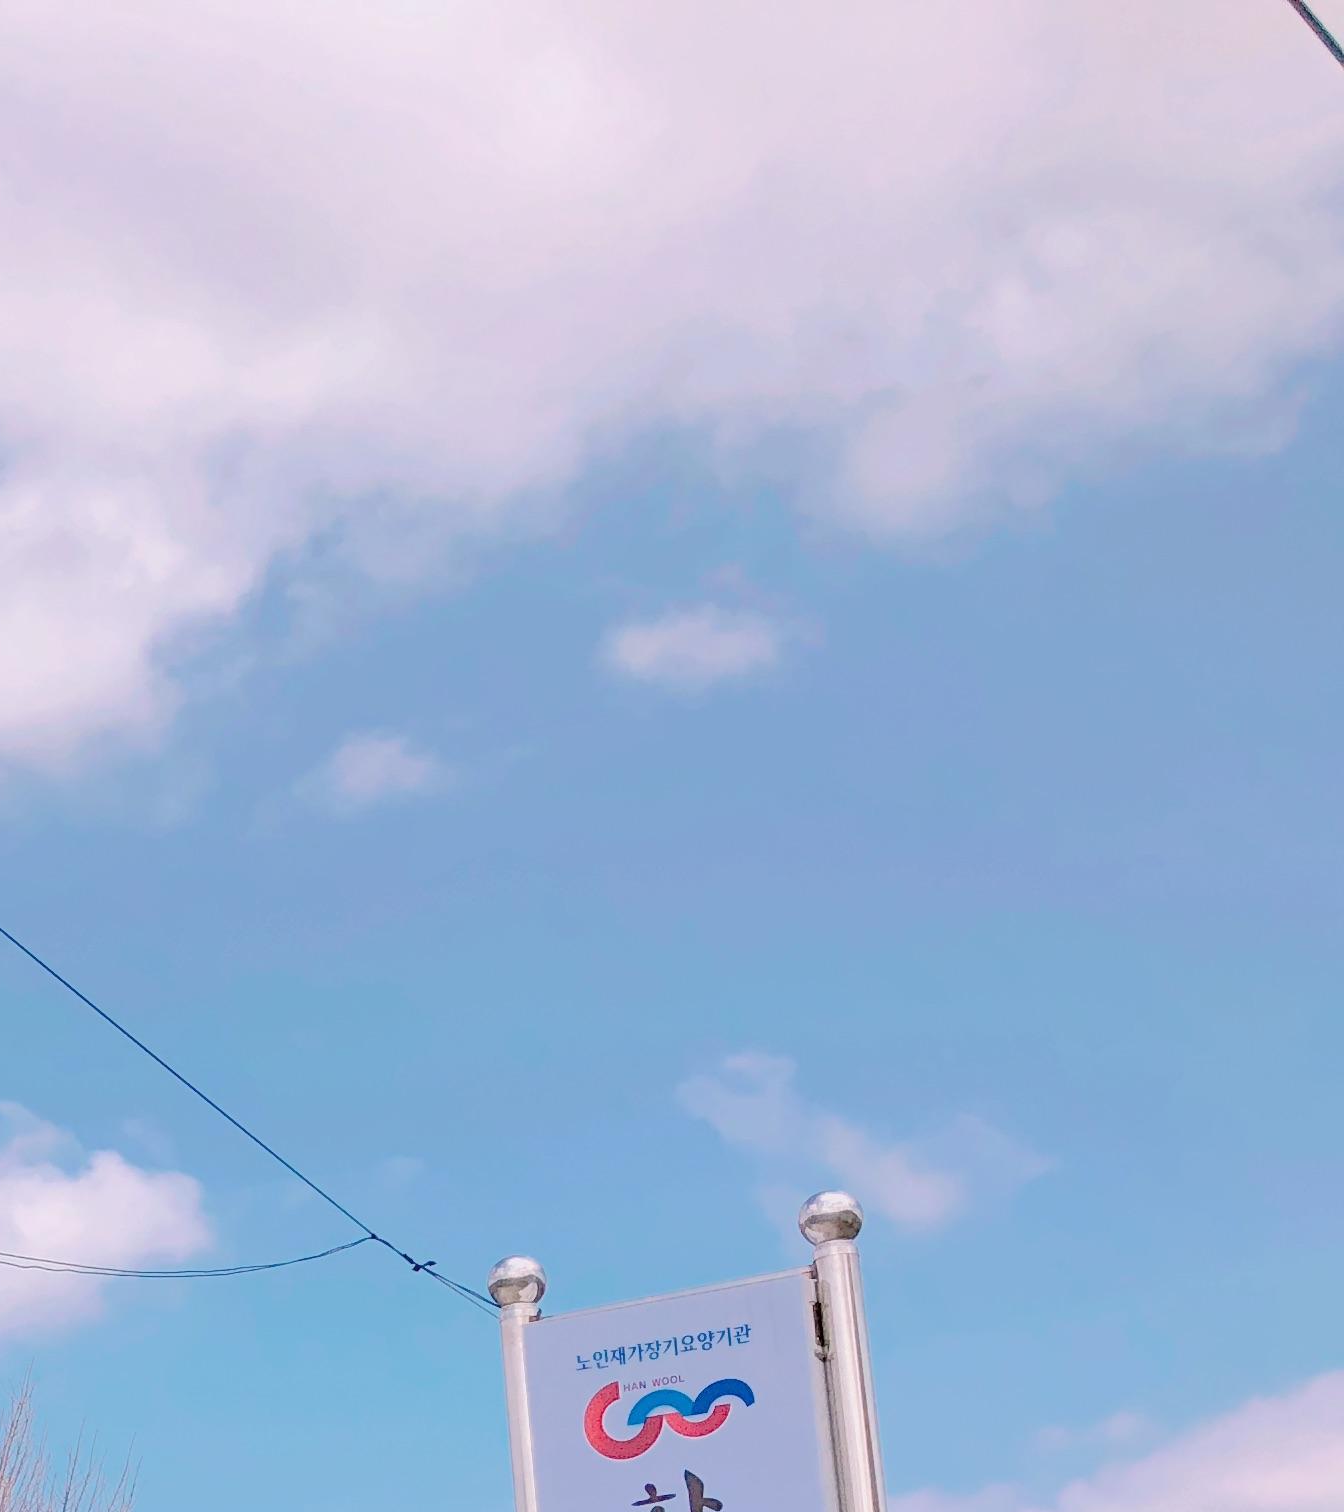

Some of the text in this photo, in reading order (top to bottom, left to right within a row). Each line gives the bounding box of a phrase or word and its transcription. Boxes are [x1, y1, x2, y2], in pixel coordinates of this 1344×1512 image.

[575, 1323, 753, 1371] 노인재가장기요양기관
[623, 1375, 685, 1393] HAN WOOL
